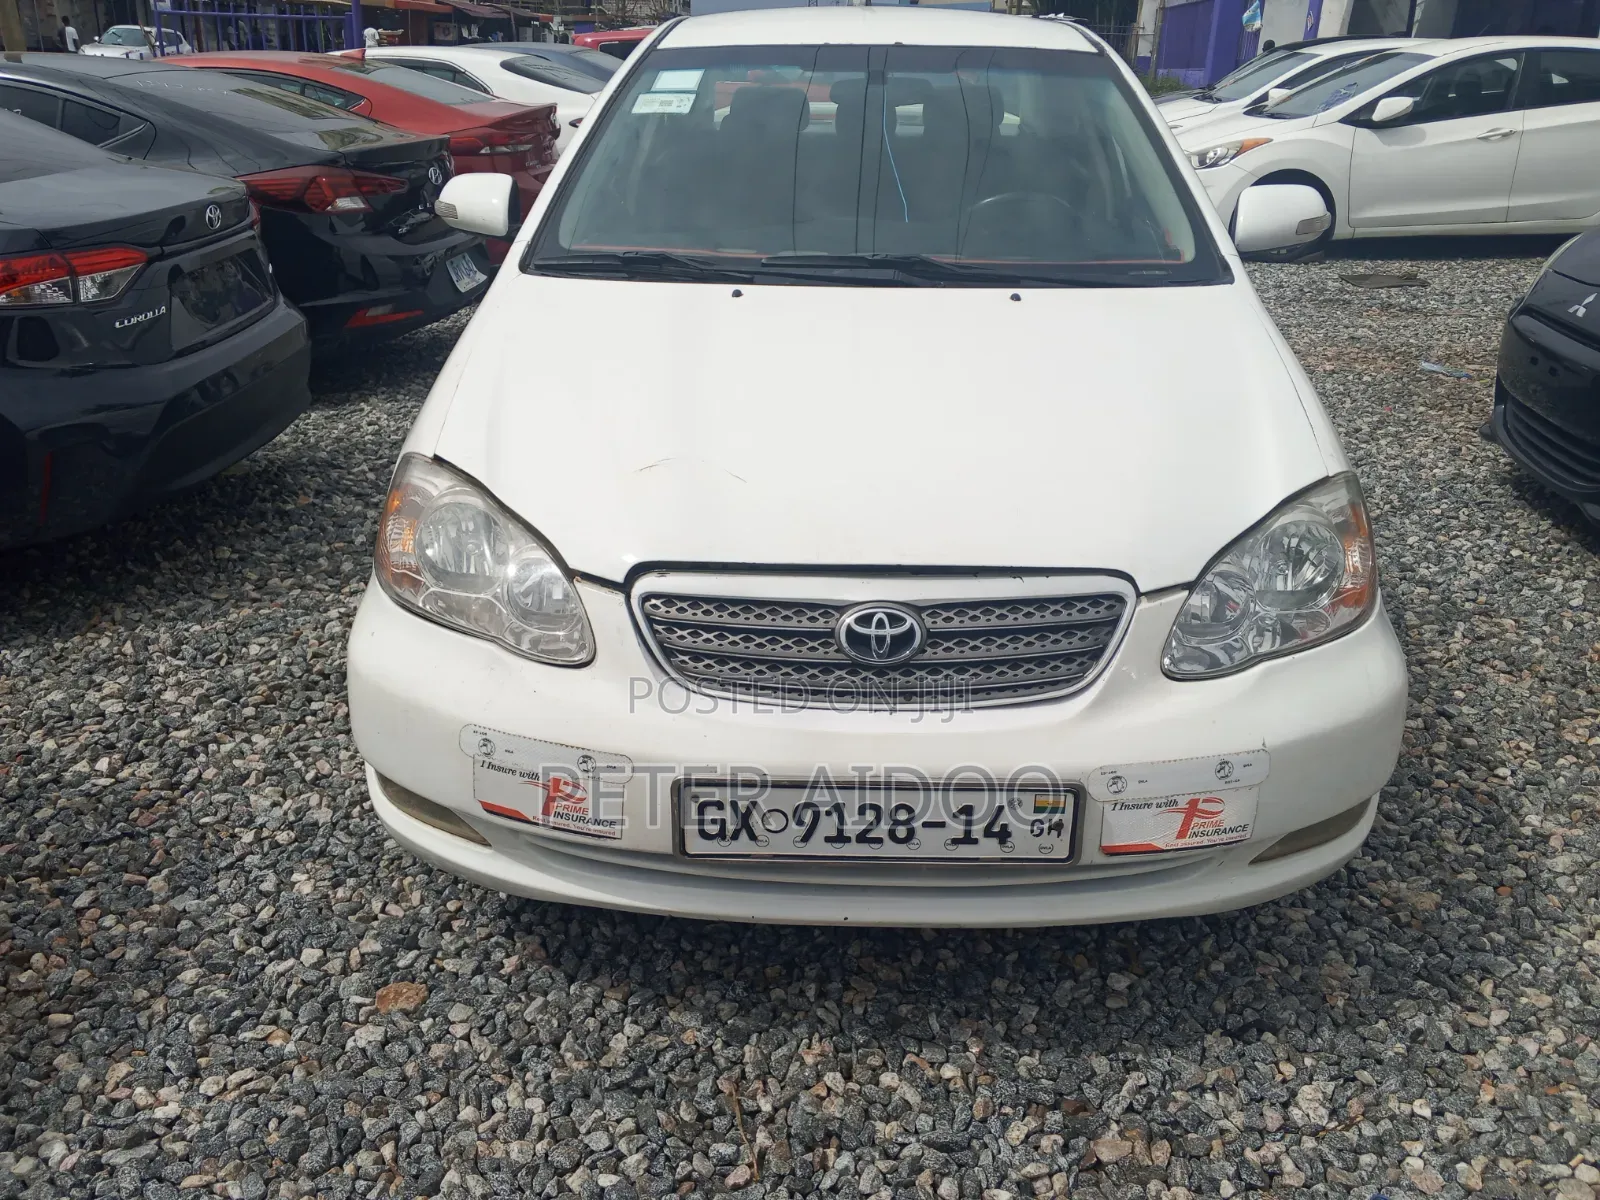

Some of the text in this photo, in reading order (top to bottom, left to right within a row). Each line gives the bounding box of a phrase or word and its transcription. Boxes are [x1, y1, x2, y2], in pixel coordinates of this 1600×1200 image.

[487, 761, 517, 776] Insure
[519, 771, 540, 781] with
[555, 803, 590, 816] PRIME
[1119, 802, 1153, 811] Insure
[1155, 799, 1179, 809] with
[553, 810, 617, 829] INSURANCE
[697, 800, 1012, 845] GX 9128-14
[1191, 819, 1225, 831] PRIME
[1188, 823, 1250, 839] INSURANCE
